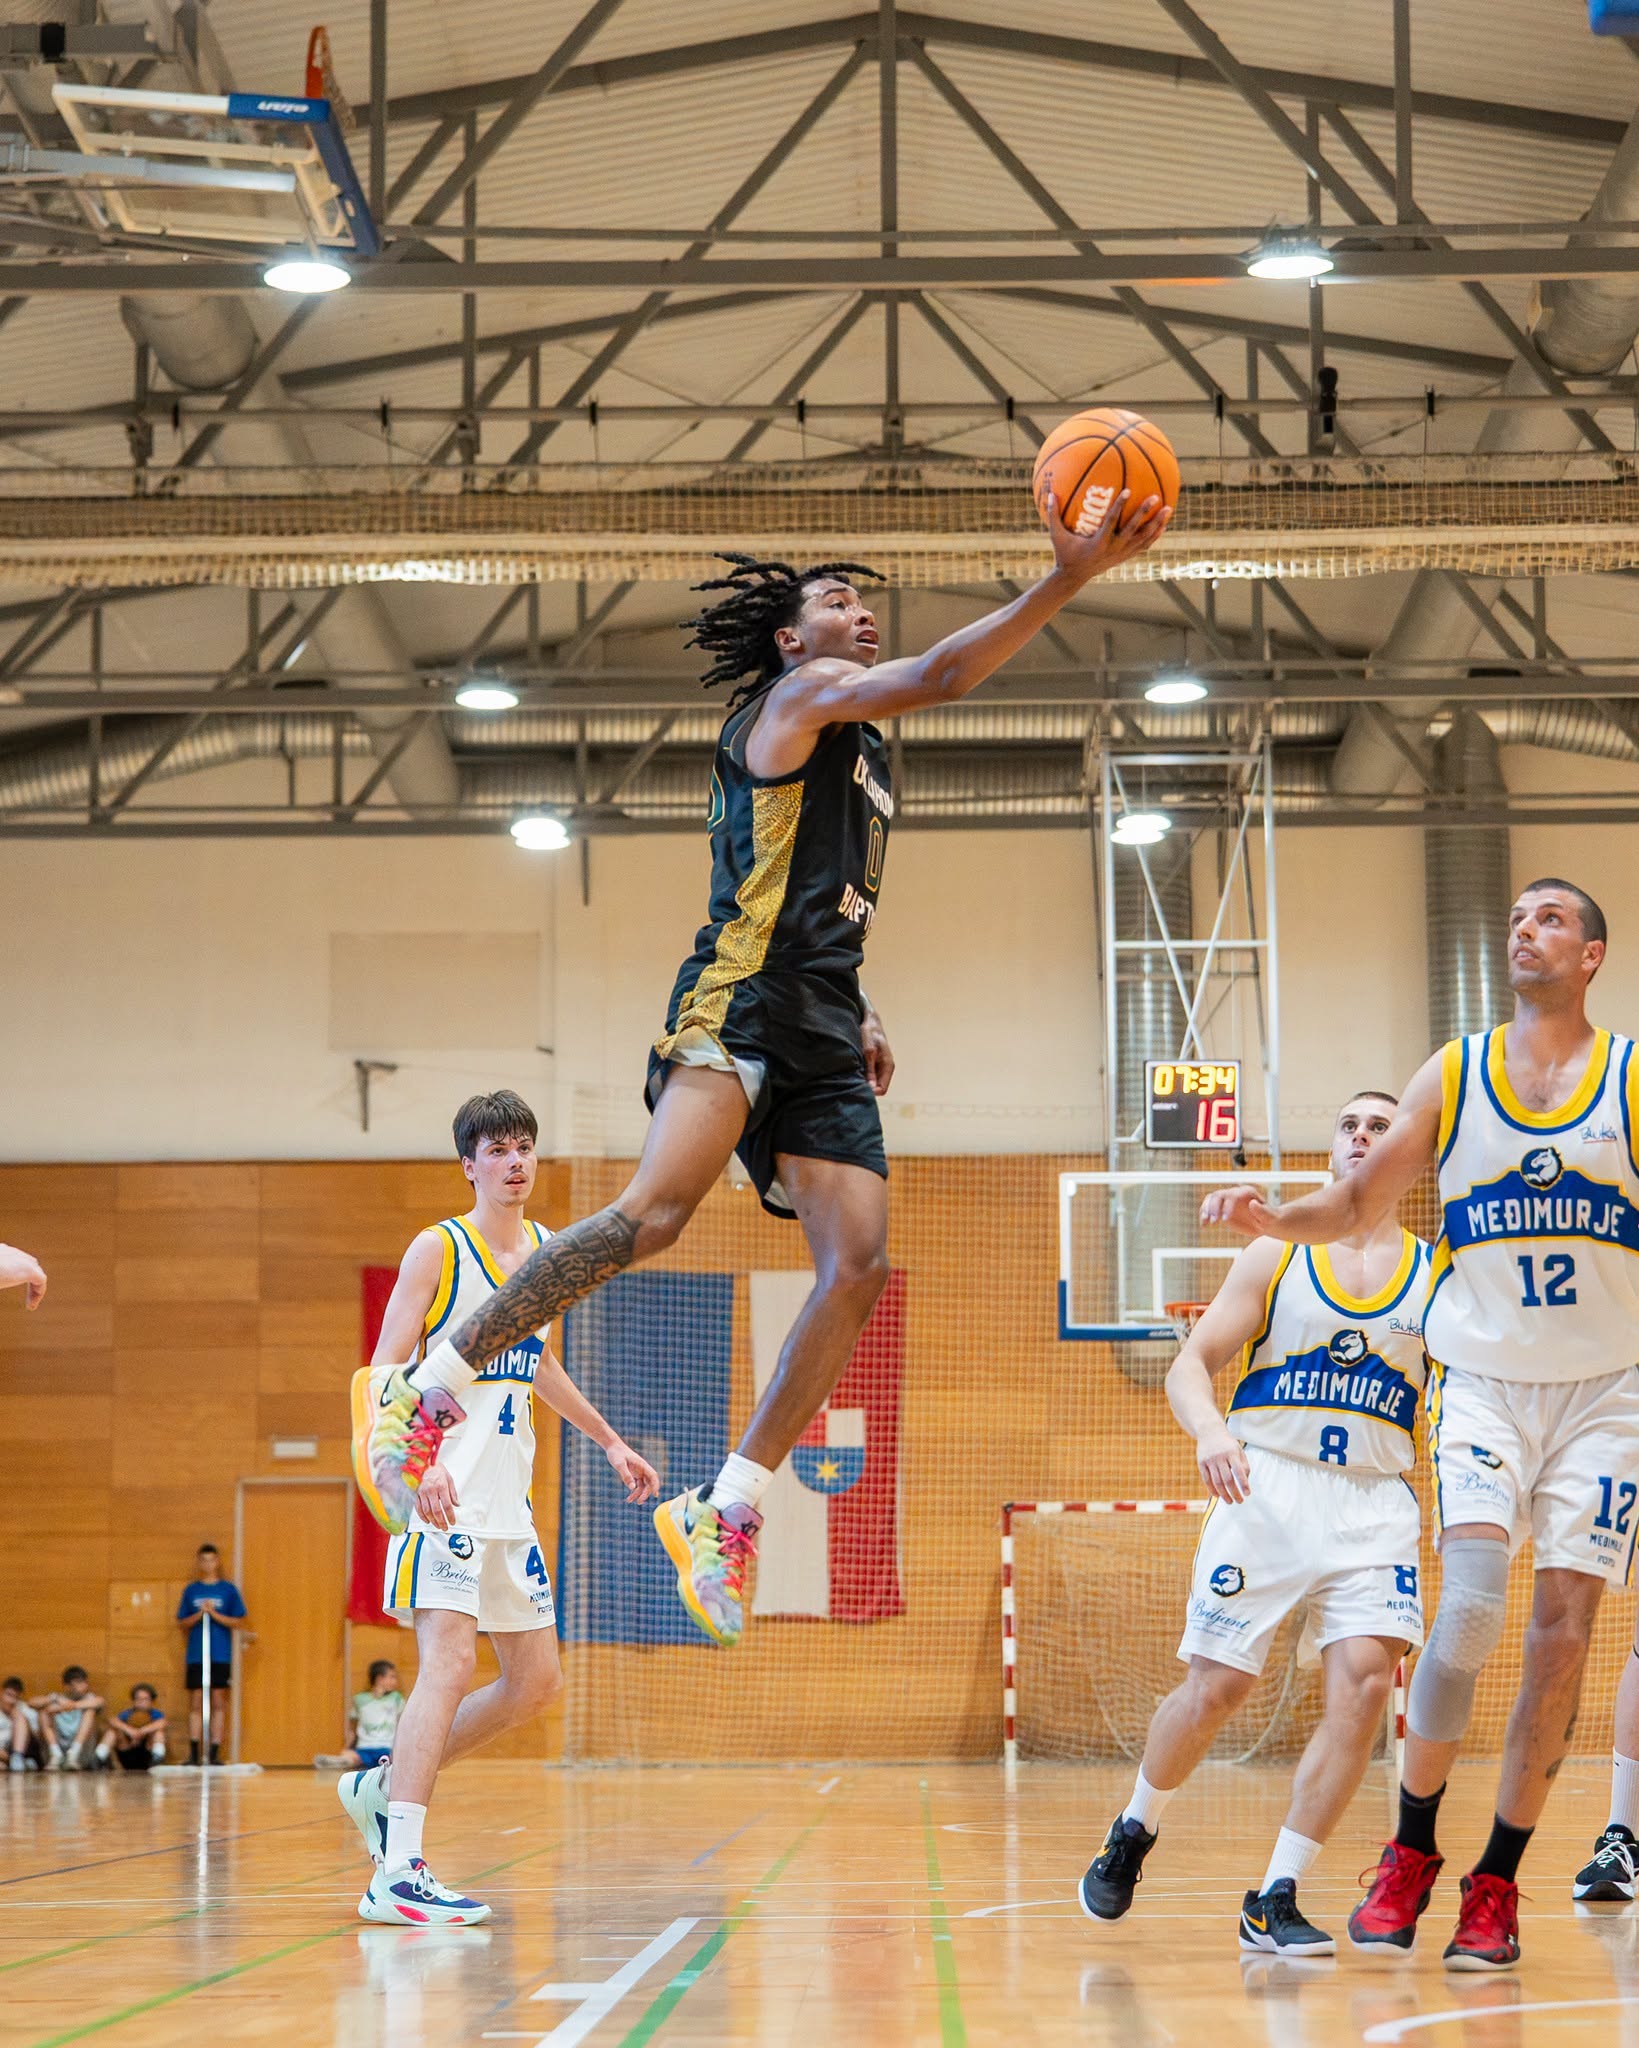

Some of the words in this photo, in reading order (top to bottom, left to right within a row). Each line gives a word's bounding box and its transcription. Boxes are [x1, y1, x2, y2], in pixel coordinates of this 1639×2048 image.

[865, 816, 884, 892] 0
[1154, 1065, 1237, 1096] 07:34
[1196, 1098, 1237, 1143] 16
[1517, 1254, 1578, 1307] 12
[498, 1393, 515, 1436] 4
[1319, 1424, 1349, 1467] 8
[1593, 1476, 1638, 1536] 12
[525, 1545, 548, 1586] 4
[1394, 1565, 1417, 1598] 8
